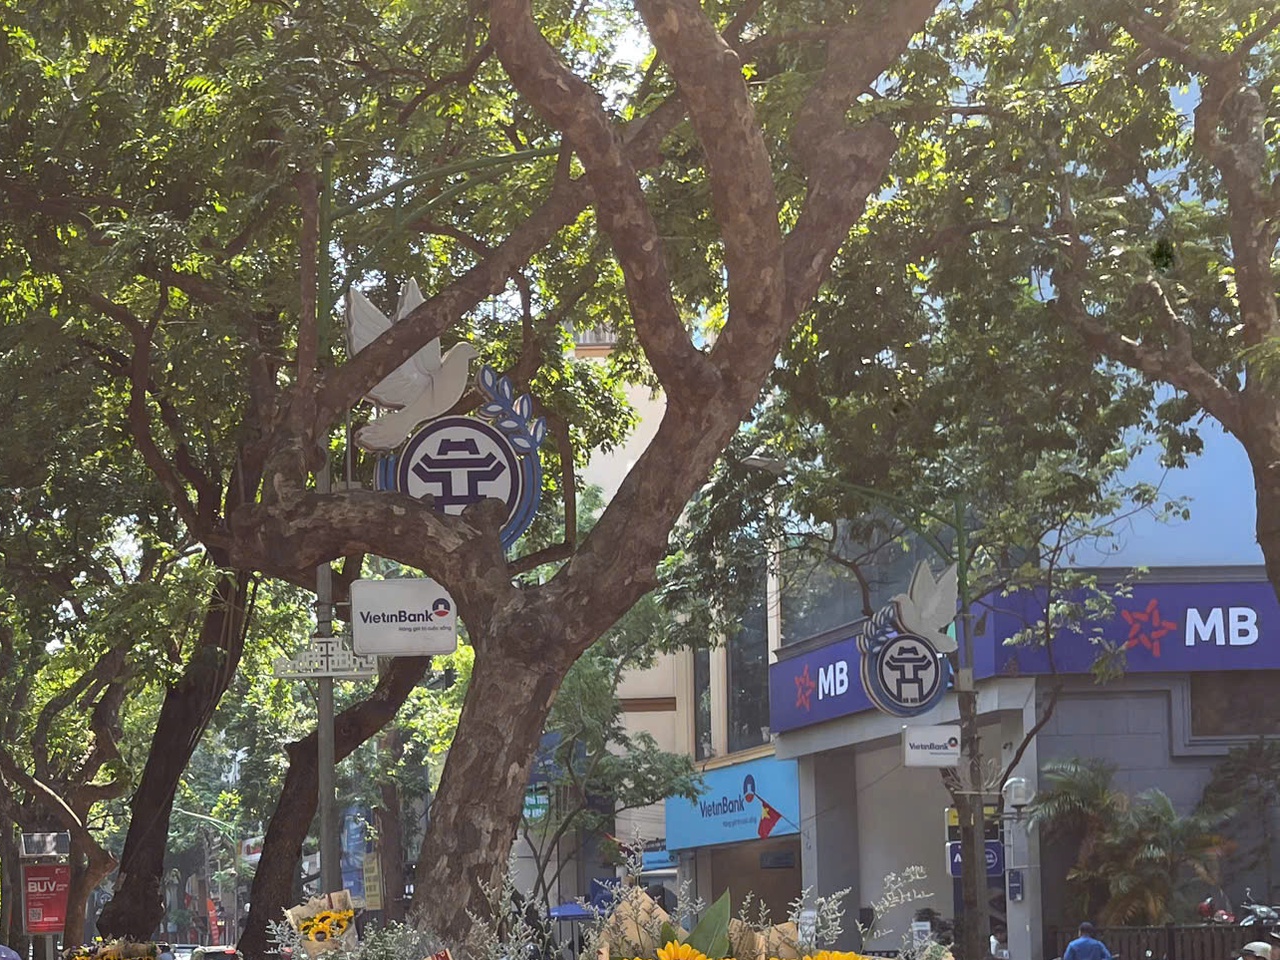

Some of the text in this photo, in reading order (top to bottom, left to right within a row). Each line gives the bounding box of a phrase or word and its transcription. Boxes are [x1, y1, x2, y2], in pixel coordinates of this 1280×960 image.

[359, 610, 434, 624] VietinBank
[1185, 606, 1259, 647] MB
[817, 660, 849, 700] MB
[908, 742, 949, 750] VietinBank
[699, 794, 745, 818] VietinBank
[28, 881, 57, 893] BUV
